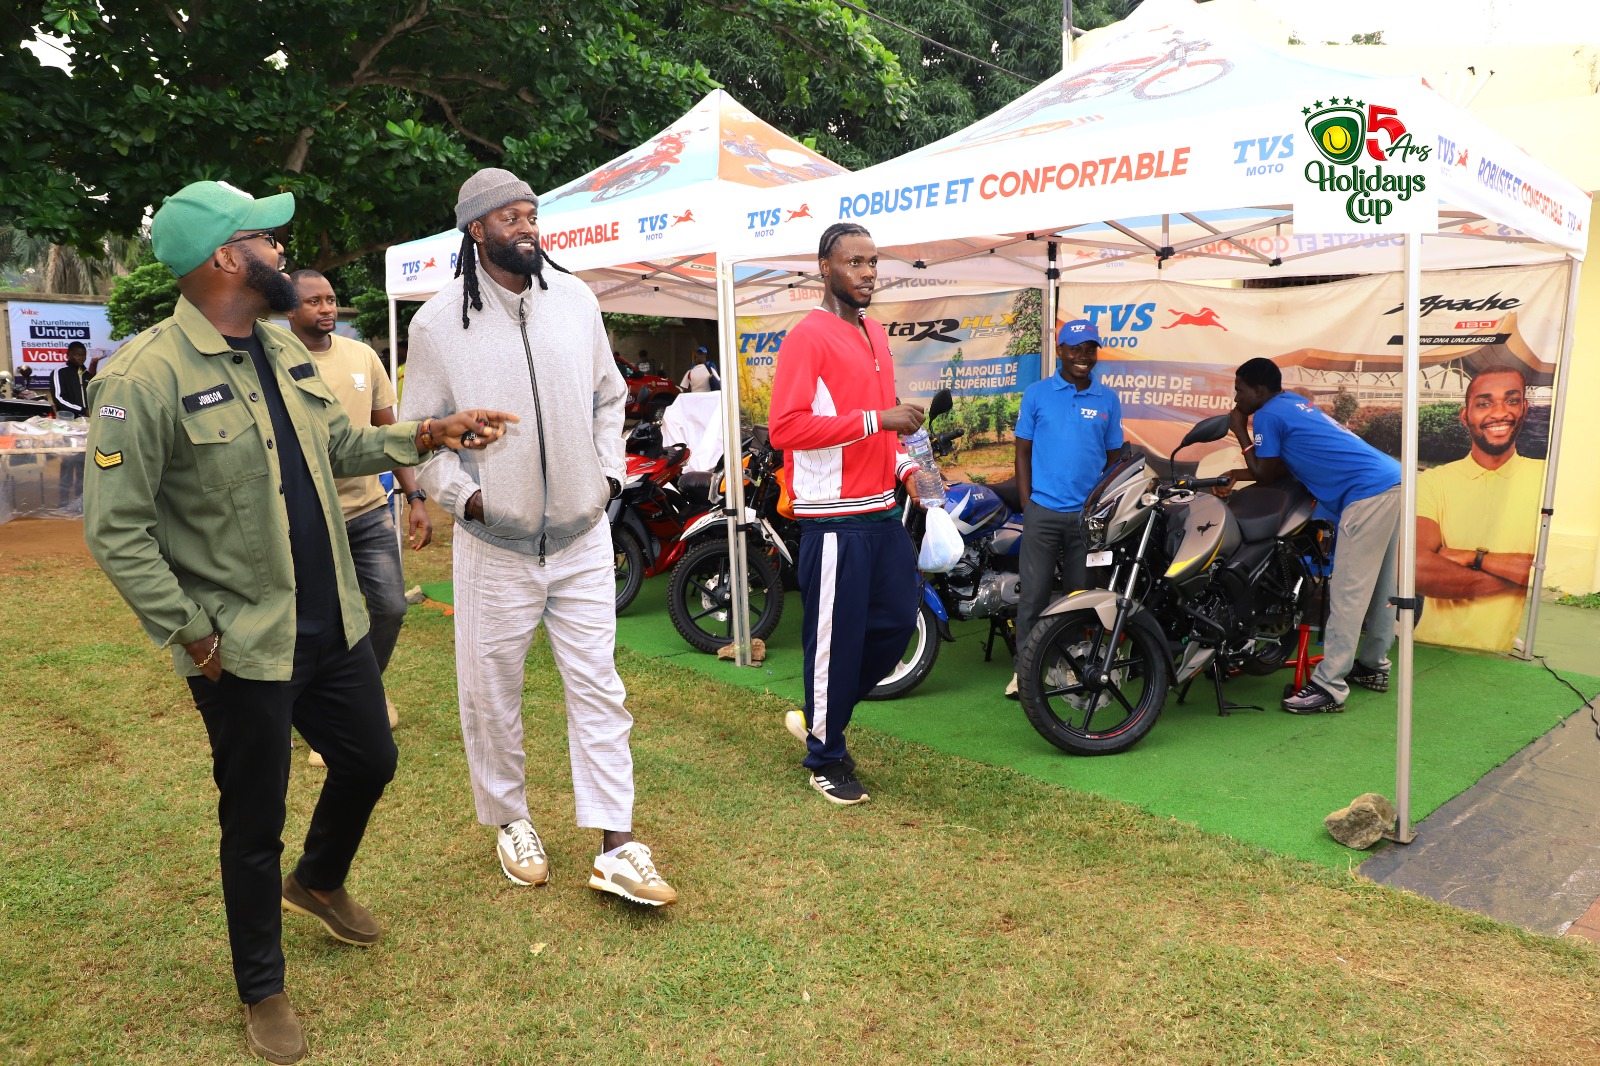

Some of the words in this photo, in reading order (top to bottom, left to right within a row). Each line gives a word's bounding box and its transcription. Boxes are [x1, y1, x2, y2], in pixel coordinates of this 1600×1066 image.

[1233, 133, 1293, 165] TVS
[1438, 134, 1455, 166] TVS
[1246, 163, 1284, 176] MOTO
[838, 182, 940, 220] ROBUSTE
[945, 177, 975, 205] ET
[979, 146, 1191, 200] CONFORTABLE
[1478, 157, 1514, 198] ROBUSTE
[1513, 177, 1522, 201] ET
[1521, 182, 1563, 225] CONFORTABLE
[638, 213, 668, 234] TVS
[747, 207, 781, 230] TVS
[540, 221, 620, 252] NFORTABLE
[645, 232, 663, 241] MOTO
[754, 228, 775, 238] MOTO
[402, 260, 420, 275] TVS
[960, 312, 1019, 329] HLX
[1083, 302, 1156, 332] TVS
[35, 327, 85, 338] Unique
[969, 326, 1007, 339] 125
[739, 330, 787, 353] TVS
[1099, 336, 1138, 348] MOTO
[746, 356, 773, 366] MOTO
[940, 367, 953, 377] LA
[956, 364, 1002, 377] MARQUE
[1005, 362, 1018, 373] DE
[909, 375, 952, 391] QUALITÉ
[954, 373, 1017, 389] SUPÉRIEURE
[1101, 374, 1166, 389] MARQUE
[1170, 376, 1192, 390] DE
[1144, 388, 1237, 410] SUPÉRIEUR
[101, 407, 119, 416] ARMY
[1080, 408, 1097, 416] TVS
